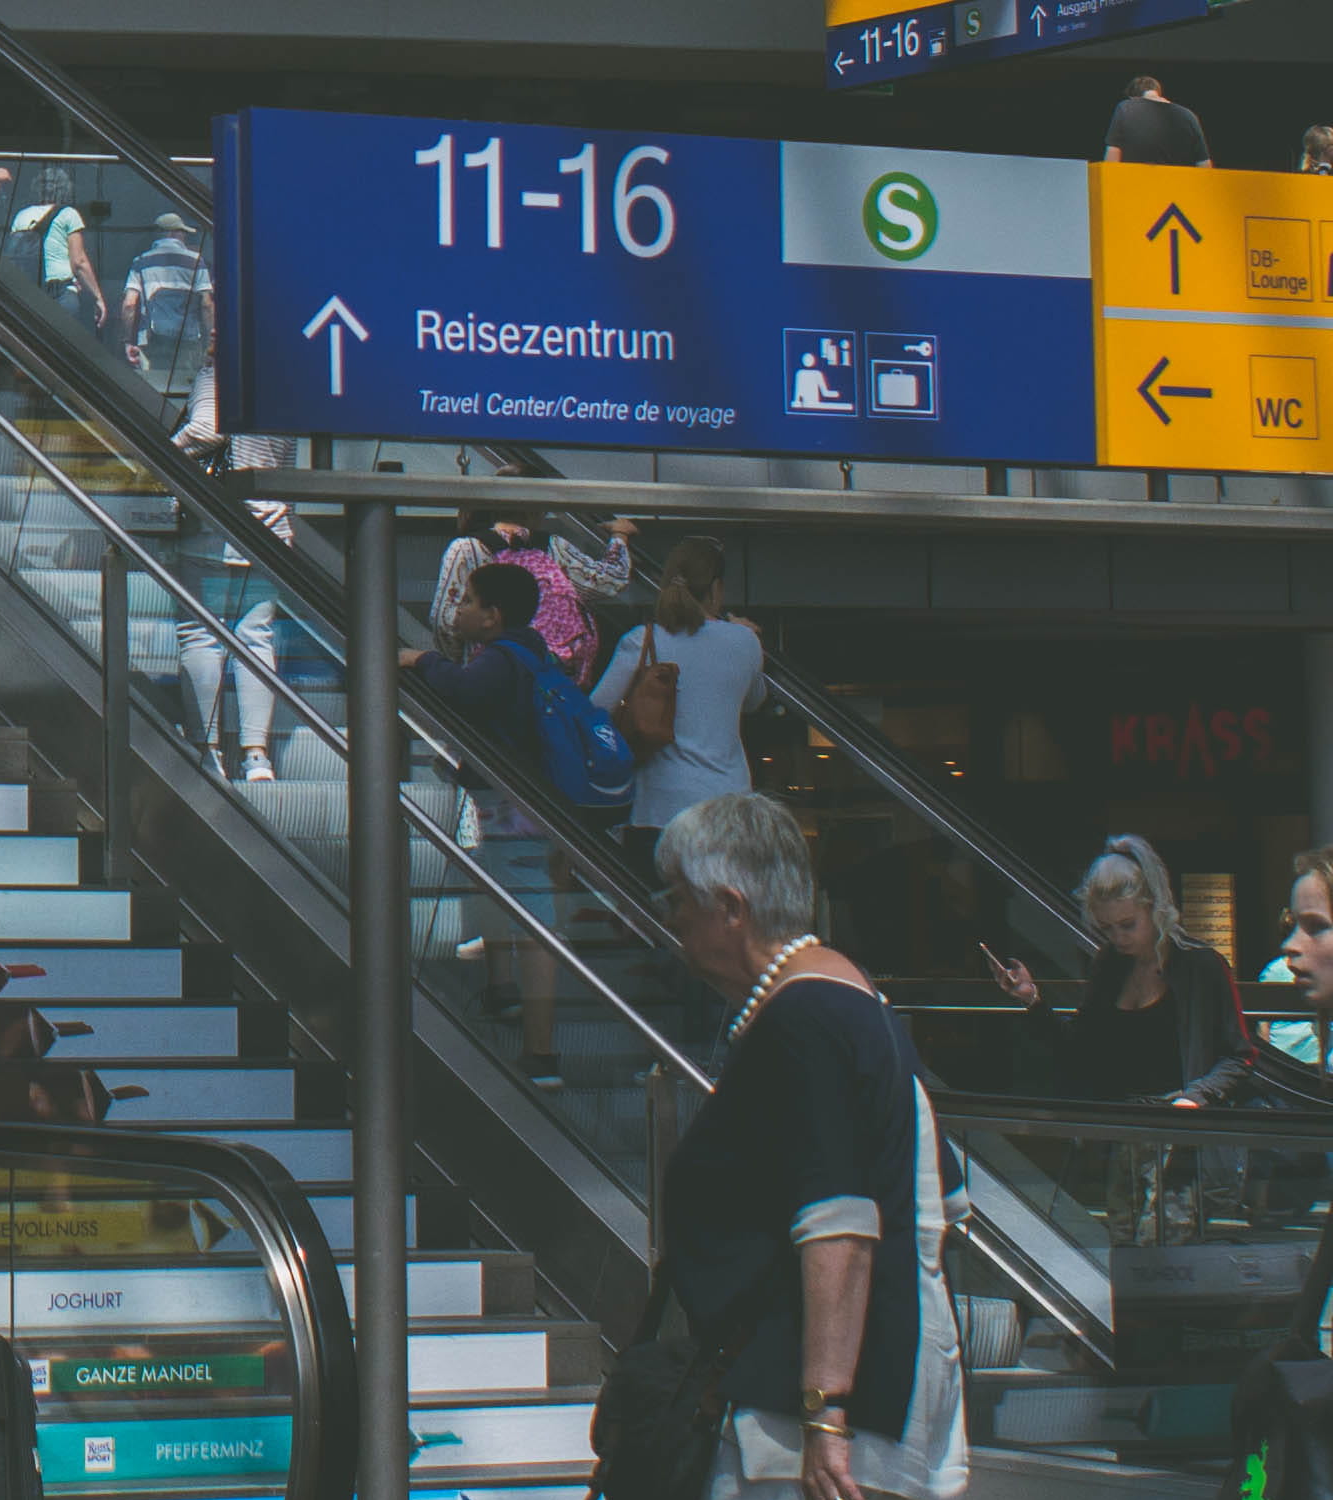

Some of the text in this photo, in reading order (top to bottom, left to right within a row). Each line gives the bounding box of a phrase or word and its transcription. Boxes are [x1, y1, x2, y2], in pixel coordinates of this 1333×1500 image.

[965, 8, 981, 37] S
[1056, 0, 1097, 18] Ausgang
[859, 18, 920, 65] 11-16
[416, 133, 676, 258] 11-16
[1250, 249, 1280, 268] DB-
[1251, 270, 1308, 295] Lounge
[416, 307, 675, 362] Reisezentrum
[419, 389, 735, 429] Travel Center/Centre de voyage
[1255, 397, 1303, 429] WC
[1111, 703, 1273, 779] KRASS
[47, 1291, 124, 1312] JOGHURT
[75, 1362, 213, 1385] GANZE MANDEL
[155, 1439, 264, 1462] PFEFFERMINZ
